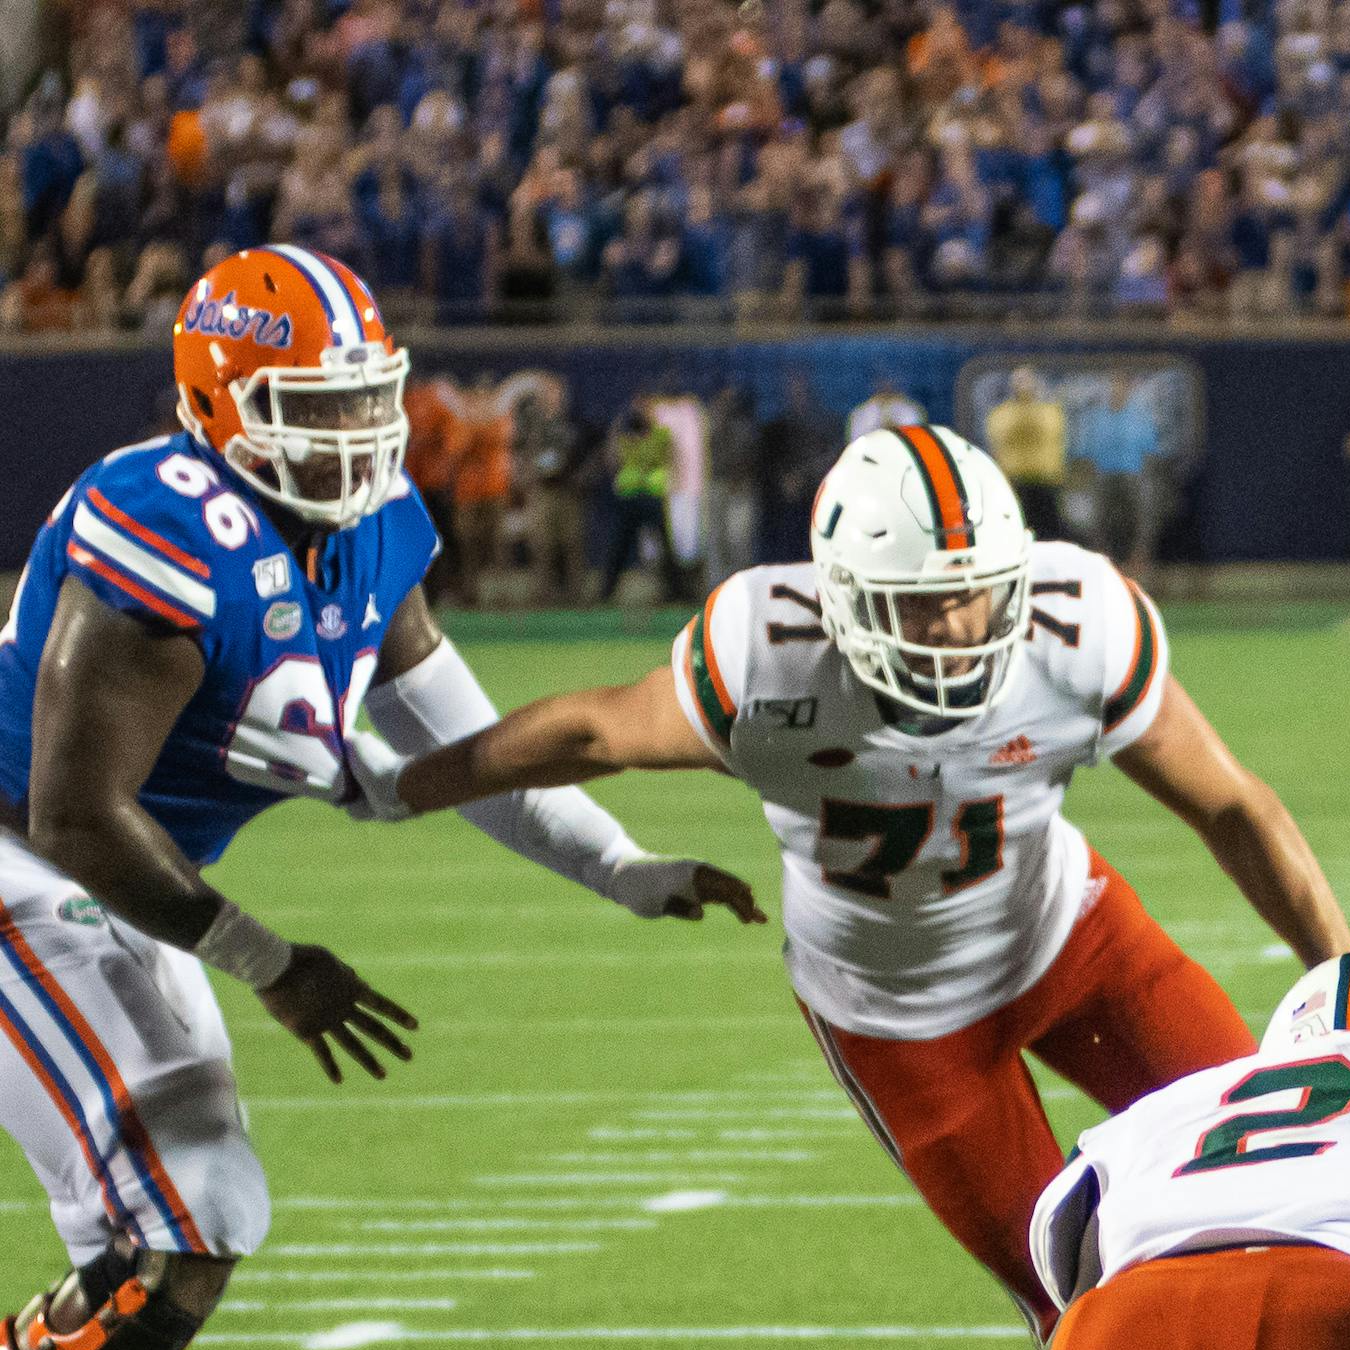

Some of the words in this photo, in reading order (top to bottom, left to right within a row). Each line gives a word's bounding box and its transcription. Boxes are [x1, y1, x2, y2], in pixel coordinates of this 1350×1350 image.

[156, 452, 260, 551] 66
[222, 648, 378, 797] 6
[820, 794, 1005, 900] 71
